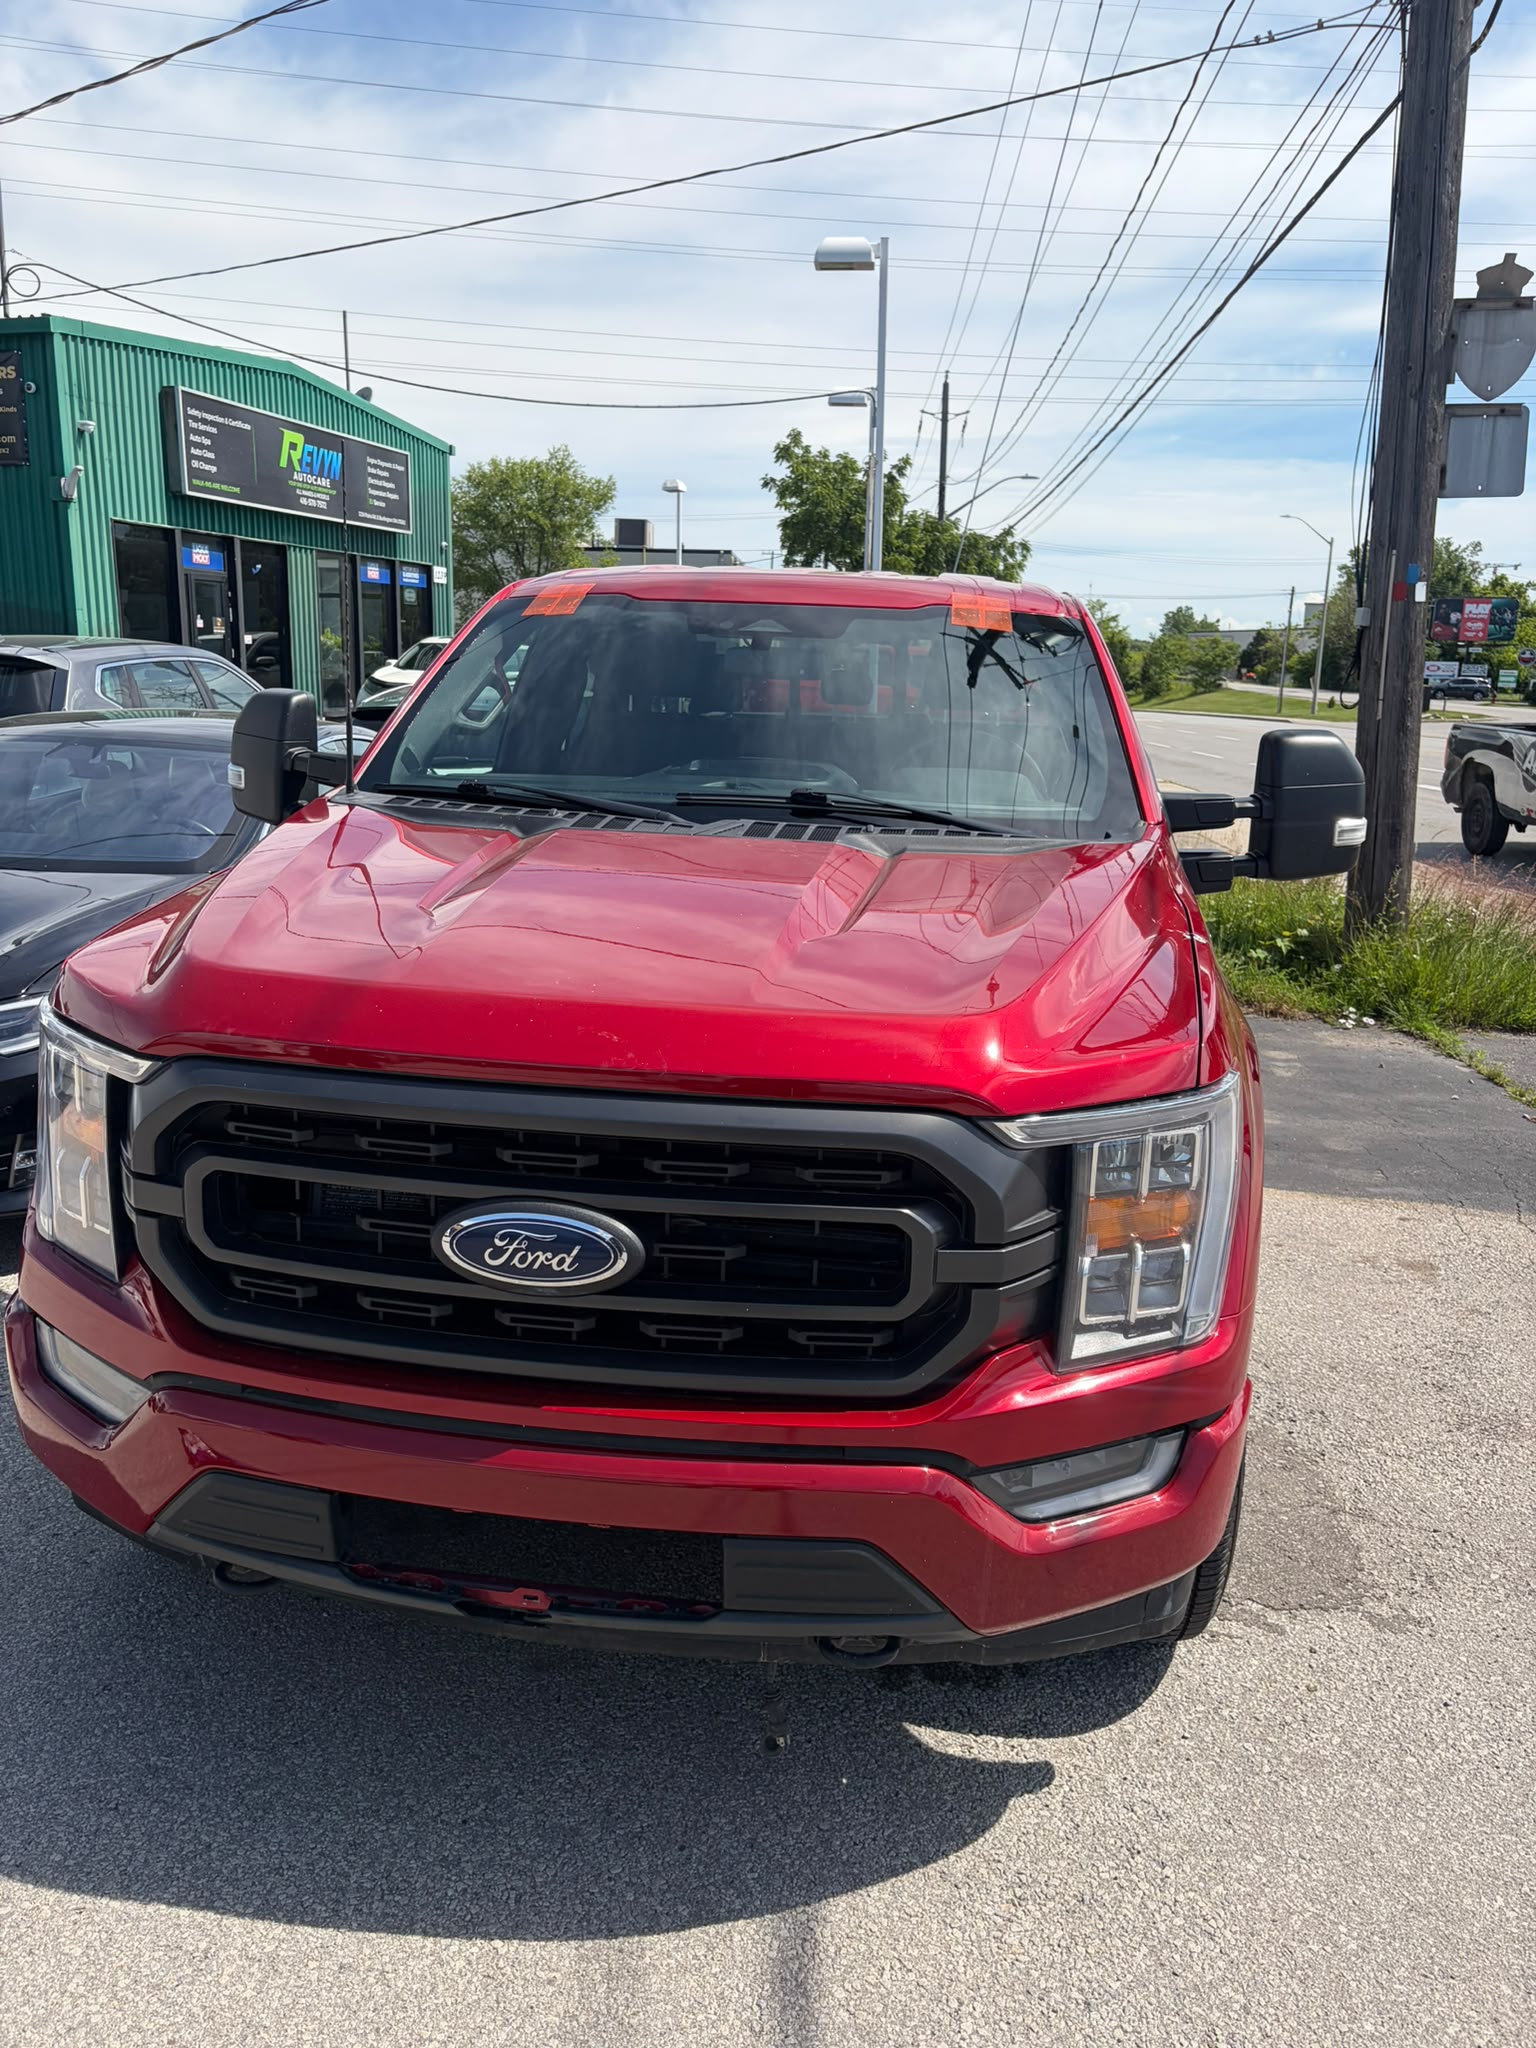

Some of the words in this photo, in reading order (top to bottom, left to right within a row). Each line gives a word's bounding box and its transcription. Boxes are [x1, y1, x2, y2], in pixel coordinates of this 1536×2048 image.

[187, 407, 201, 418] Safety
[228, 418, 251, 431] Certificate
[188, 419, 198, 429] Tire
[198, 421, 218, 434] Services
[189, 433, 202, 443] Auto
[202, 435, 211, 445] Spa
[190, 446, 203, 456] Auto
[202, 448, 215, 459] Glass
[279, 427, 342, 480] REVYN
[191, 459, 199, 469] Oil
[199, 461, 218, 473] Change
[293, 471, 331, 488] AUTOCARE
[192, 552, 210, 565] MOLY
[1464, 603, 1492, 614] PLAY
[483, 1228, 582, 1272] Ford
